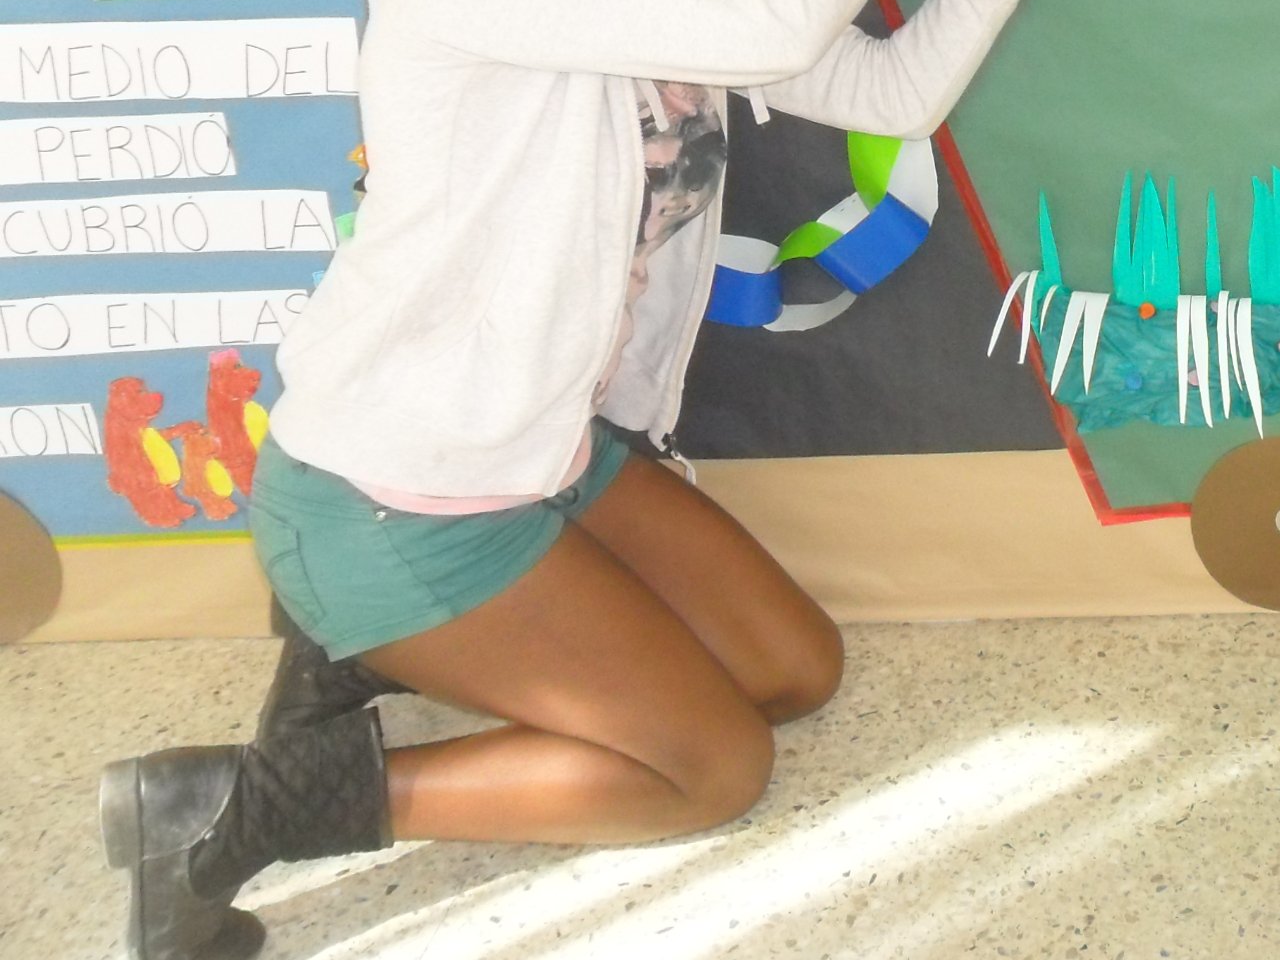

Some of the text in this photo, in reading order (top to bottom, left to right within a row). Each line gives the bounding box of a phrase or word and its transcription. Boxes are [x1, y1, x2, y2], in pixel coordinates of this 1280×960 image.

[18, 41, 360, 101] MEDIO DEL
[34, 113, 232, 182] PERDIÓ
[261, 198, 334, 251] LA
[106, 299, 179, 348] EN
[0, 405, 98, 457] ON
